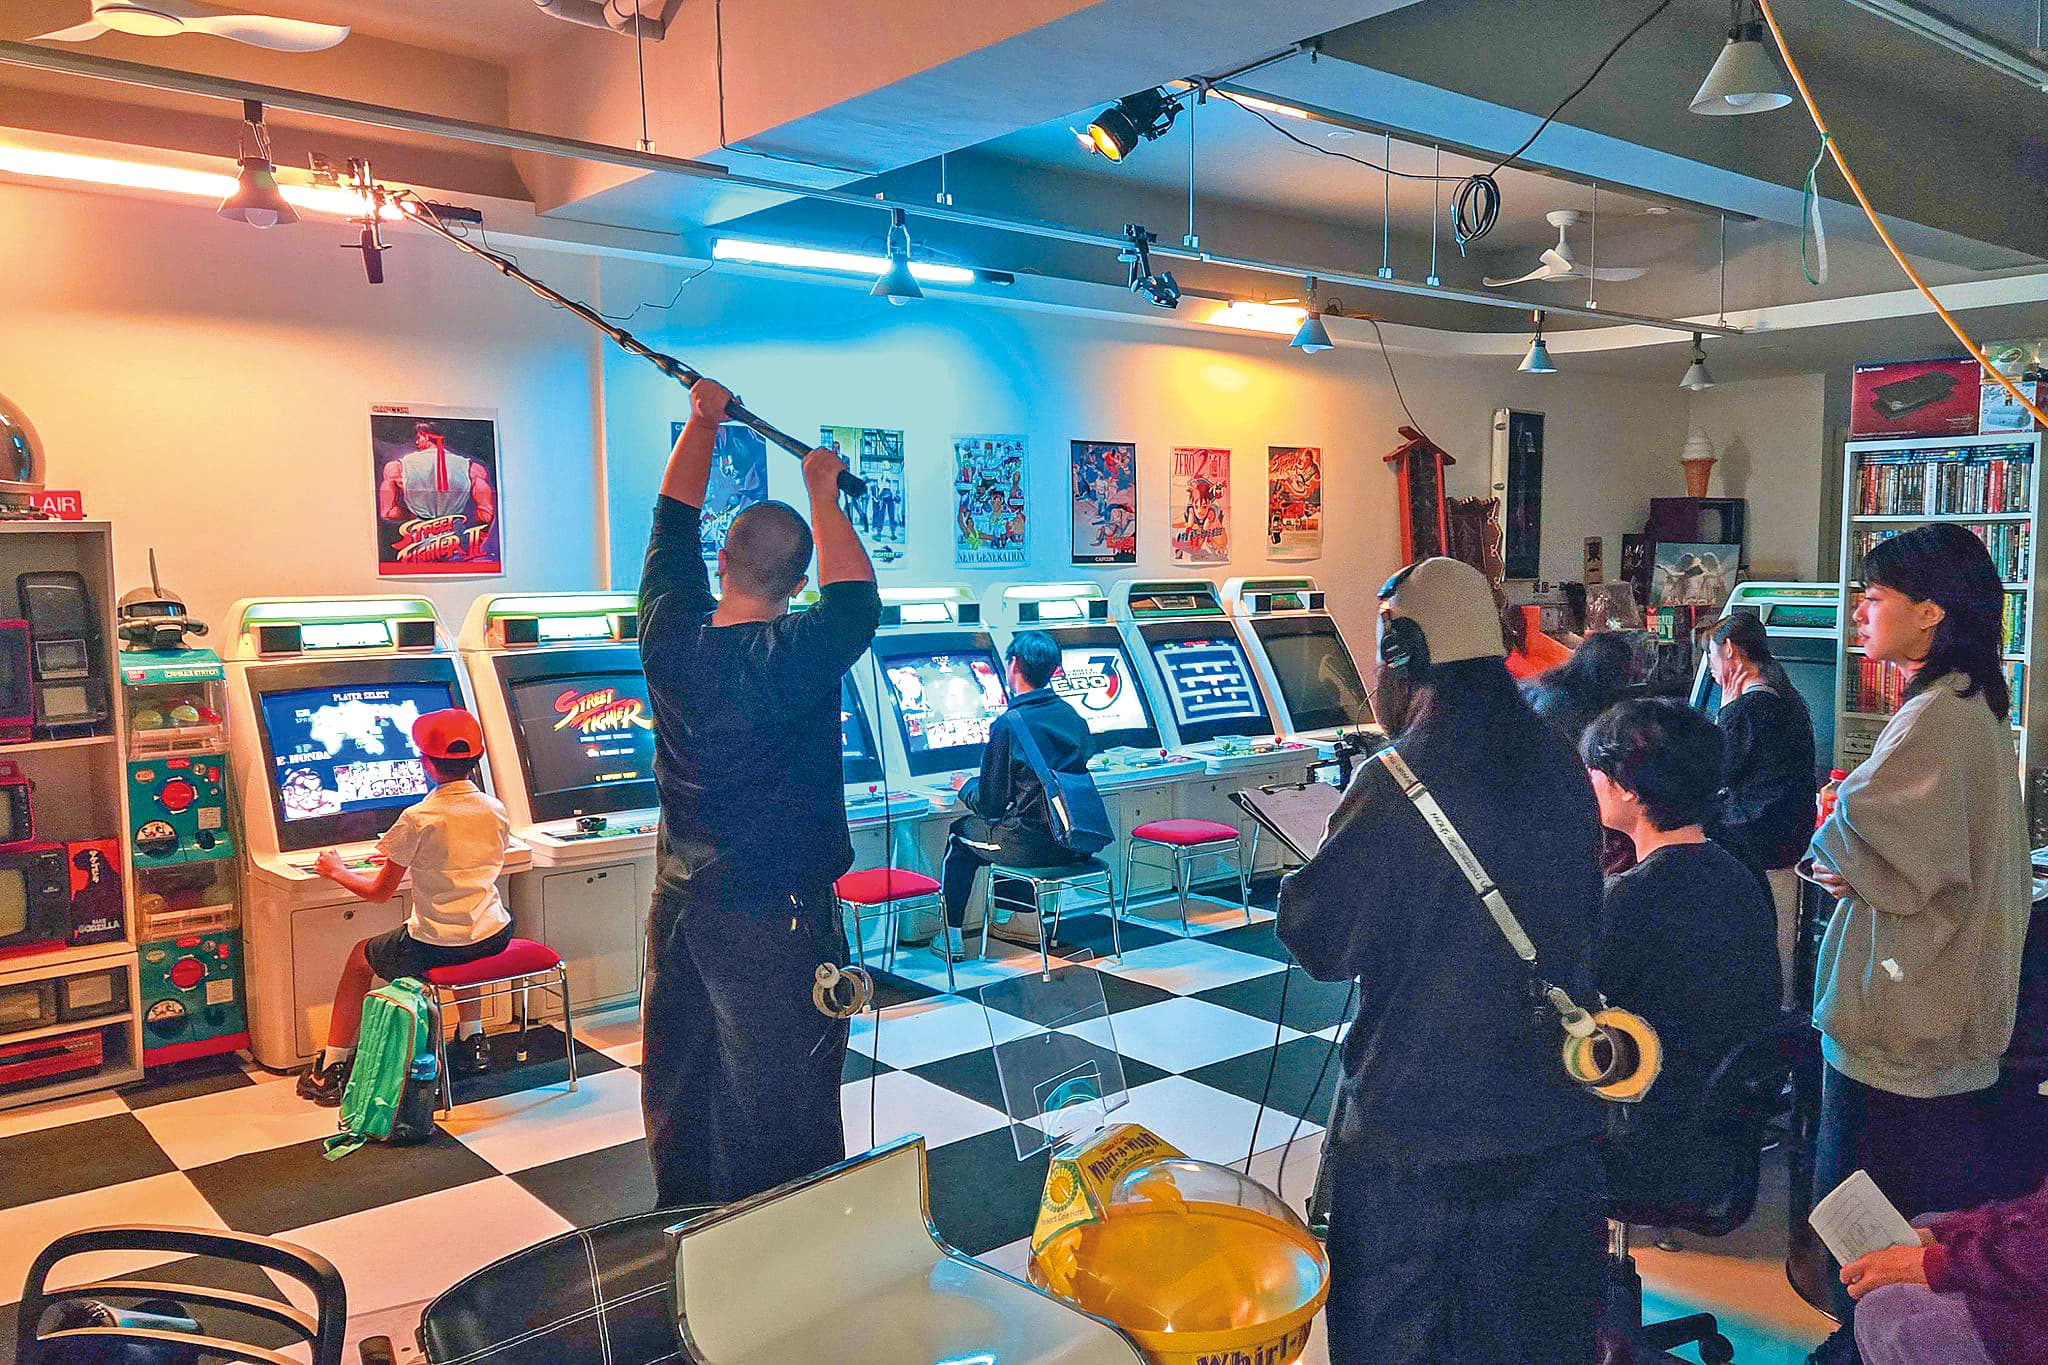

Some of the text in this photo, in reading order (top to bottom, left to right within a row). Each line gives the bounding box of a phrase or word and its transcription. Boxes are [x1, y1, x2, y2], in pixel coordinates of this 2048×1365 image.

[1174, 452, 1195, 476] ZERO
[1193, 449, 1209, 479] 2
[43, 496, 77, 512] AIR
[391, 514, 467, 551] STREET
[397, 524, 489, 564] FIGHTER II
[957, 551, 1025, 562] NEW GENERATION
[1051, 676, 1108, 692] ERO
[333, 691, 390, 702] PLAYER SELECT
[553, 688, 615, 732] STREET
[568, 698, 654, 735] FIGHTER
[79, 920, 120, 934] GODZILLA
